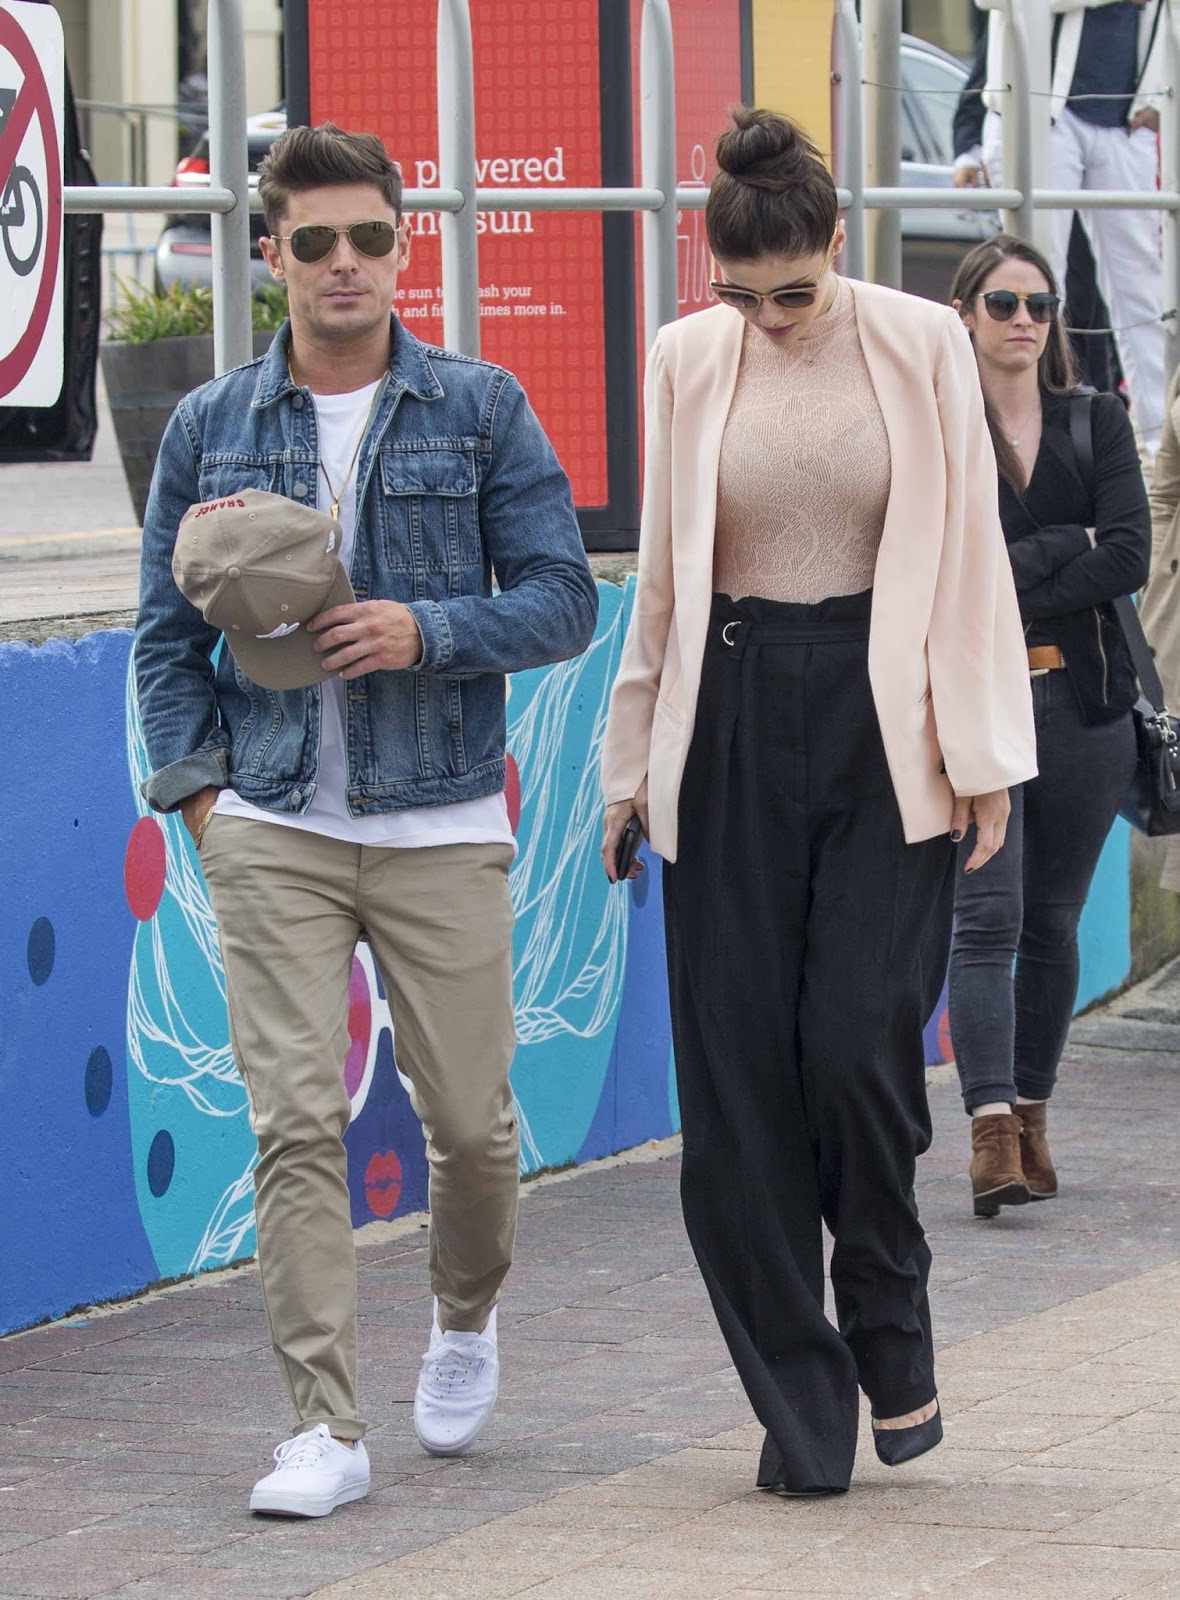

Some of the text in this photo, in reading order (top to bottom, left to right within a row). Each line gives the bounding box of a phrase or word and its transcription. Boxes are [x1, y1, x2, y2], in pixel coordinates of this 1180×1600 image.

[415, 146, 566, 189] pered
[476, 210, 534, 234] sun
[408, 288, 433, 299] sun
[503, 287, 532, 300] your
[403, 304, 428, 317] and
[480, 303, 511, 317] imes
[514, 305, 547, 316] more
[550, 302, 567, 316] in.
